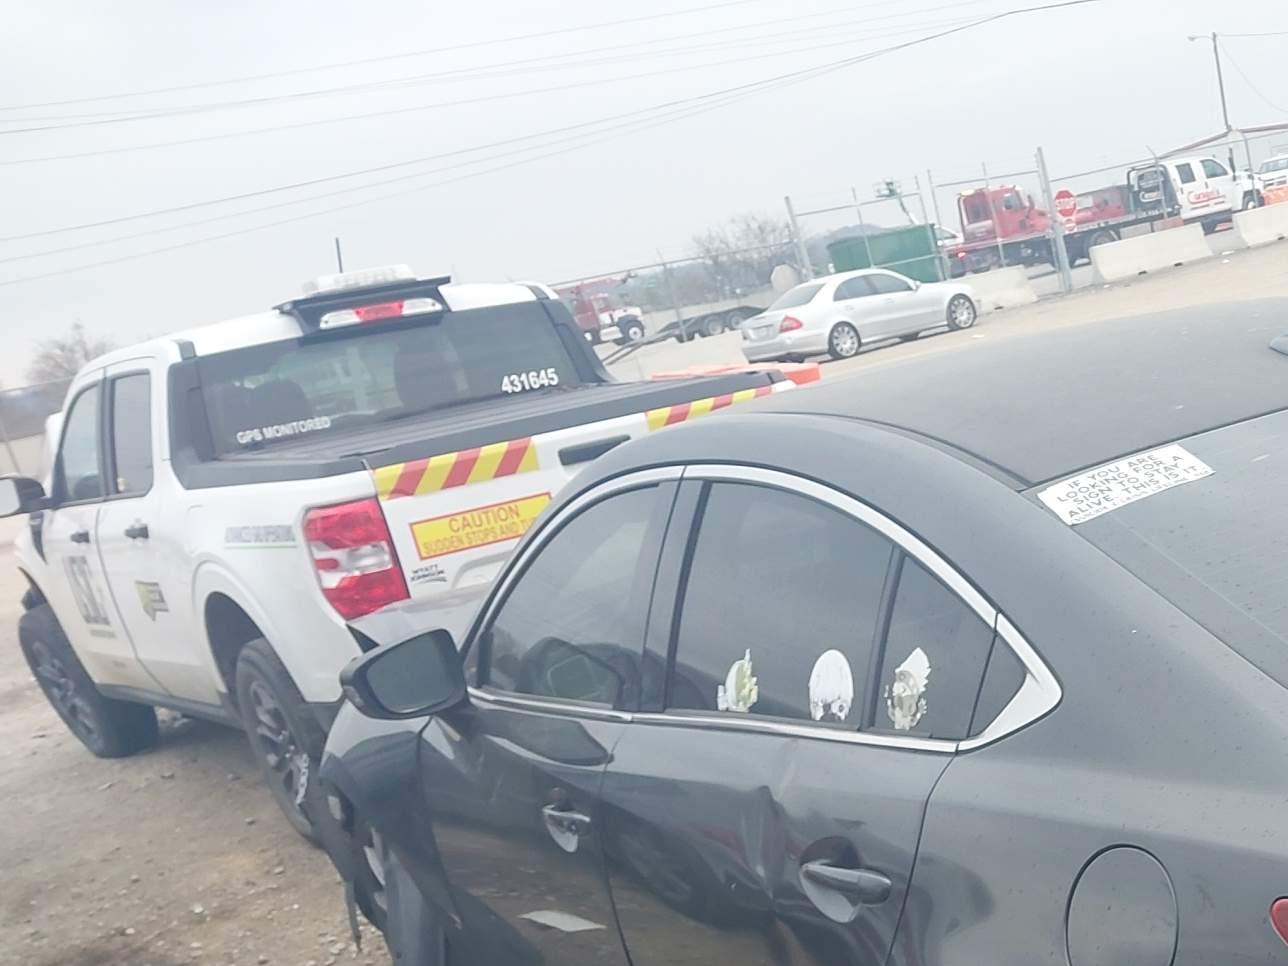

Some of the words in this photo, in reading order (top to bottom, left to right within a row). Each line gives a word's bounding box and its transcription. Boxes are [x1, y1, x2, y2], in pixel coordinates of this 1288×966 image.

[502, 368, 559, 393] 431645
[237, 429, 263, 443] GPS
[262, 416, 331, 439] MONITORED
[1057, 472, 1128, 502] LOOKING
[1132, 460, 1166, 473] FOR
[1067, 479, 1081, 489] IF
[1087, 466, 1121, 481] YOU
[1127, 454, 1158, 468] ARE
[1073, 487, 1113, 505] SIGN
[1116, 477, 1139, 487] TO
[1143, 462, 1179, 477] STAY
[1121, 478, 1160, 494] THIS
[1163, 471, 1180, 480] IS
[447, 503, 521, 534] CAUTION
[423, 534, 465, 556] SUDDEN
[466, 525, 498, 547] STOPS
